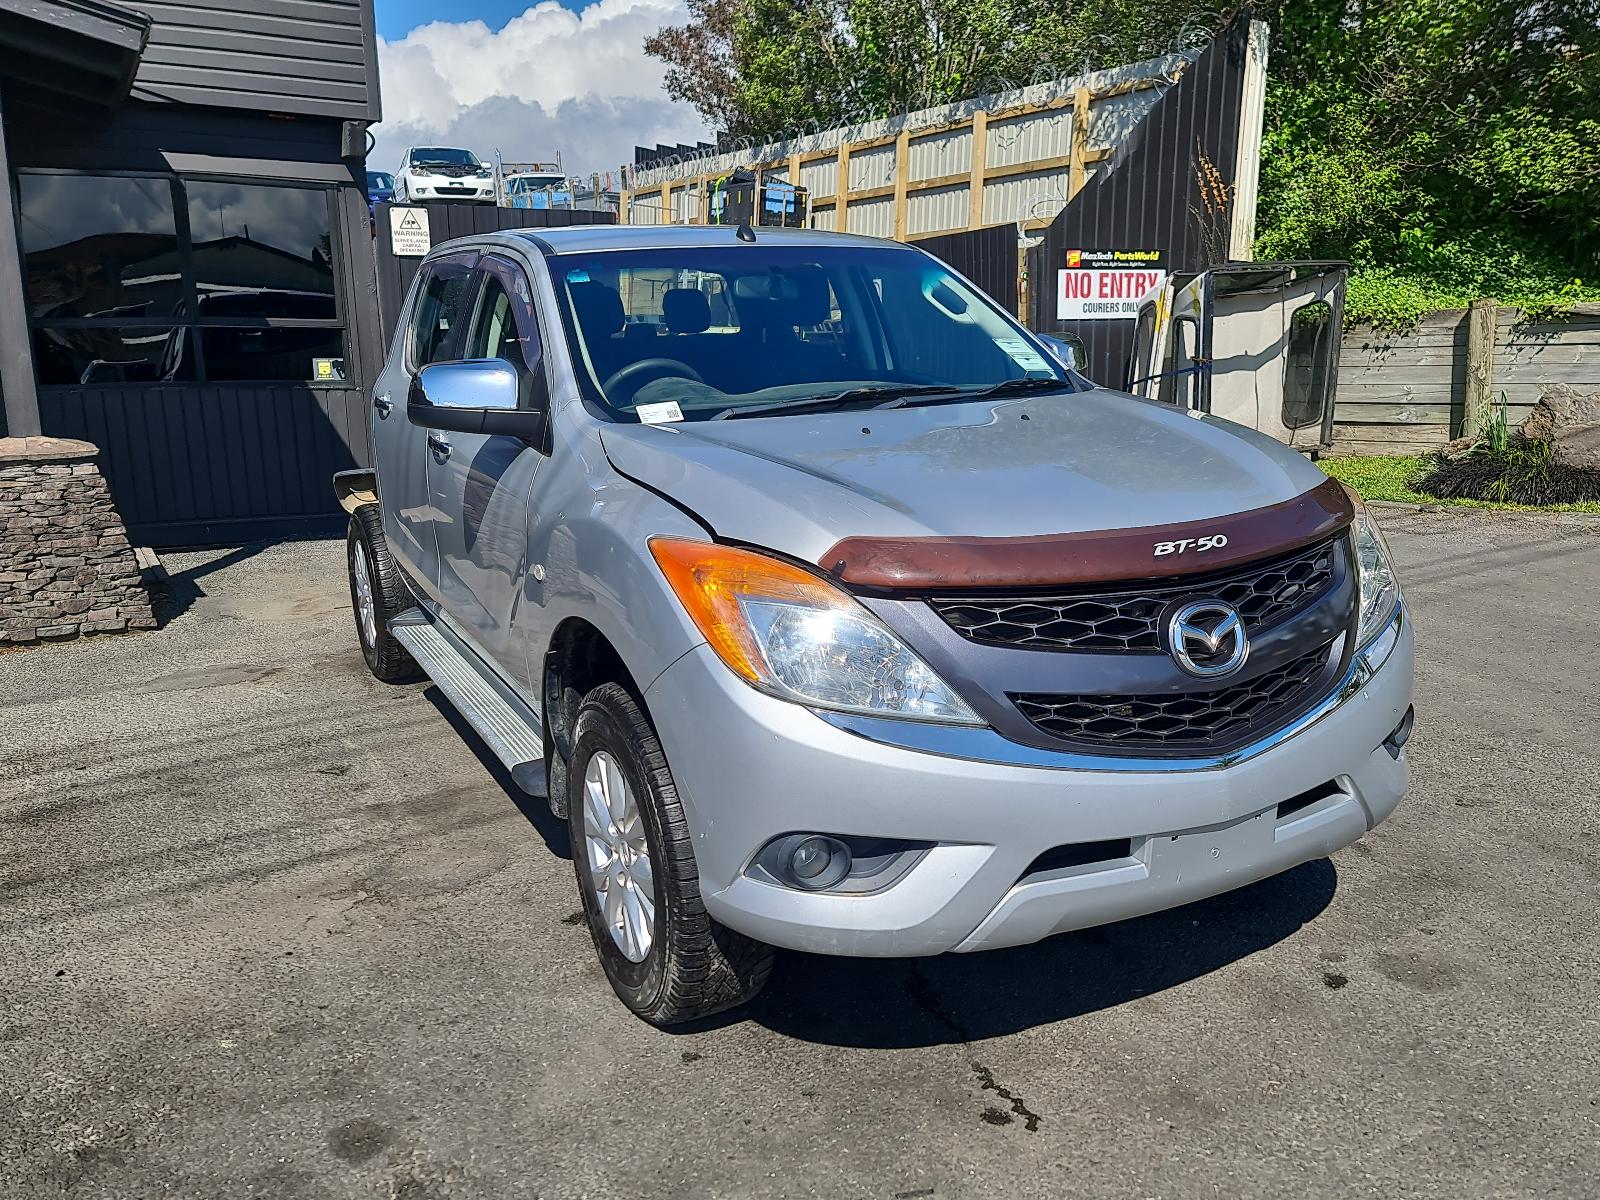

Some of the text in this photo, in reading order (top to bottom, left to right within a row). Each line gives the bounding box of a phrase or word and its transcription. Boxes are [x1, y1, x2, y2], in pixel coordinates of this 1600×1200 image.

[1080, 251, 1113, 260] MazTech
[1113, 251, 1160, 261] PartsWorld
[1065, 272, 1092, 299] NO
[1082, 302, 1120, 313] COURIERS
[1153, 534, 1228, 556] BT-50
